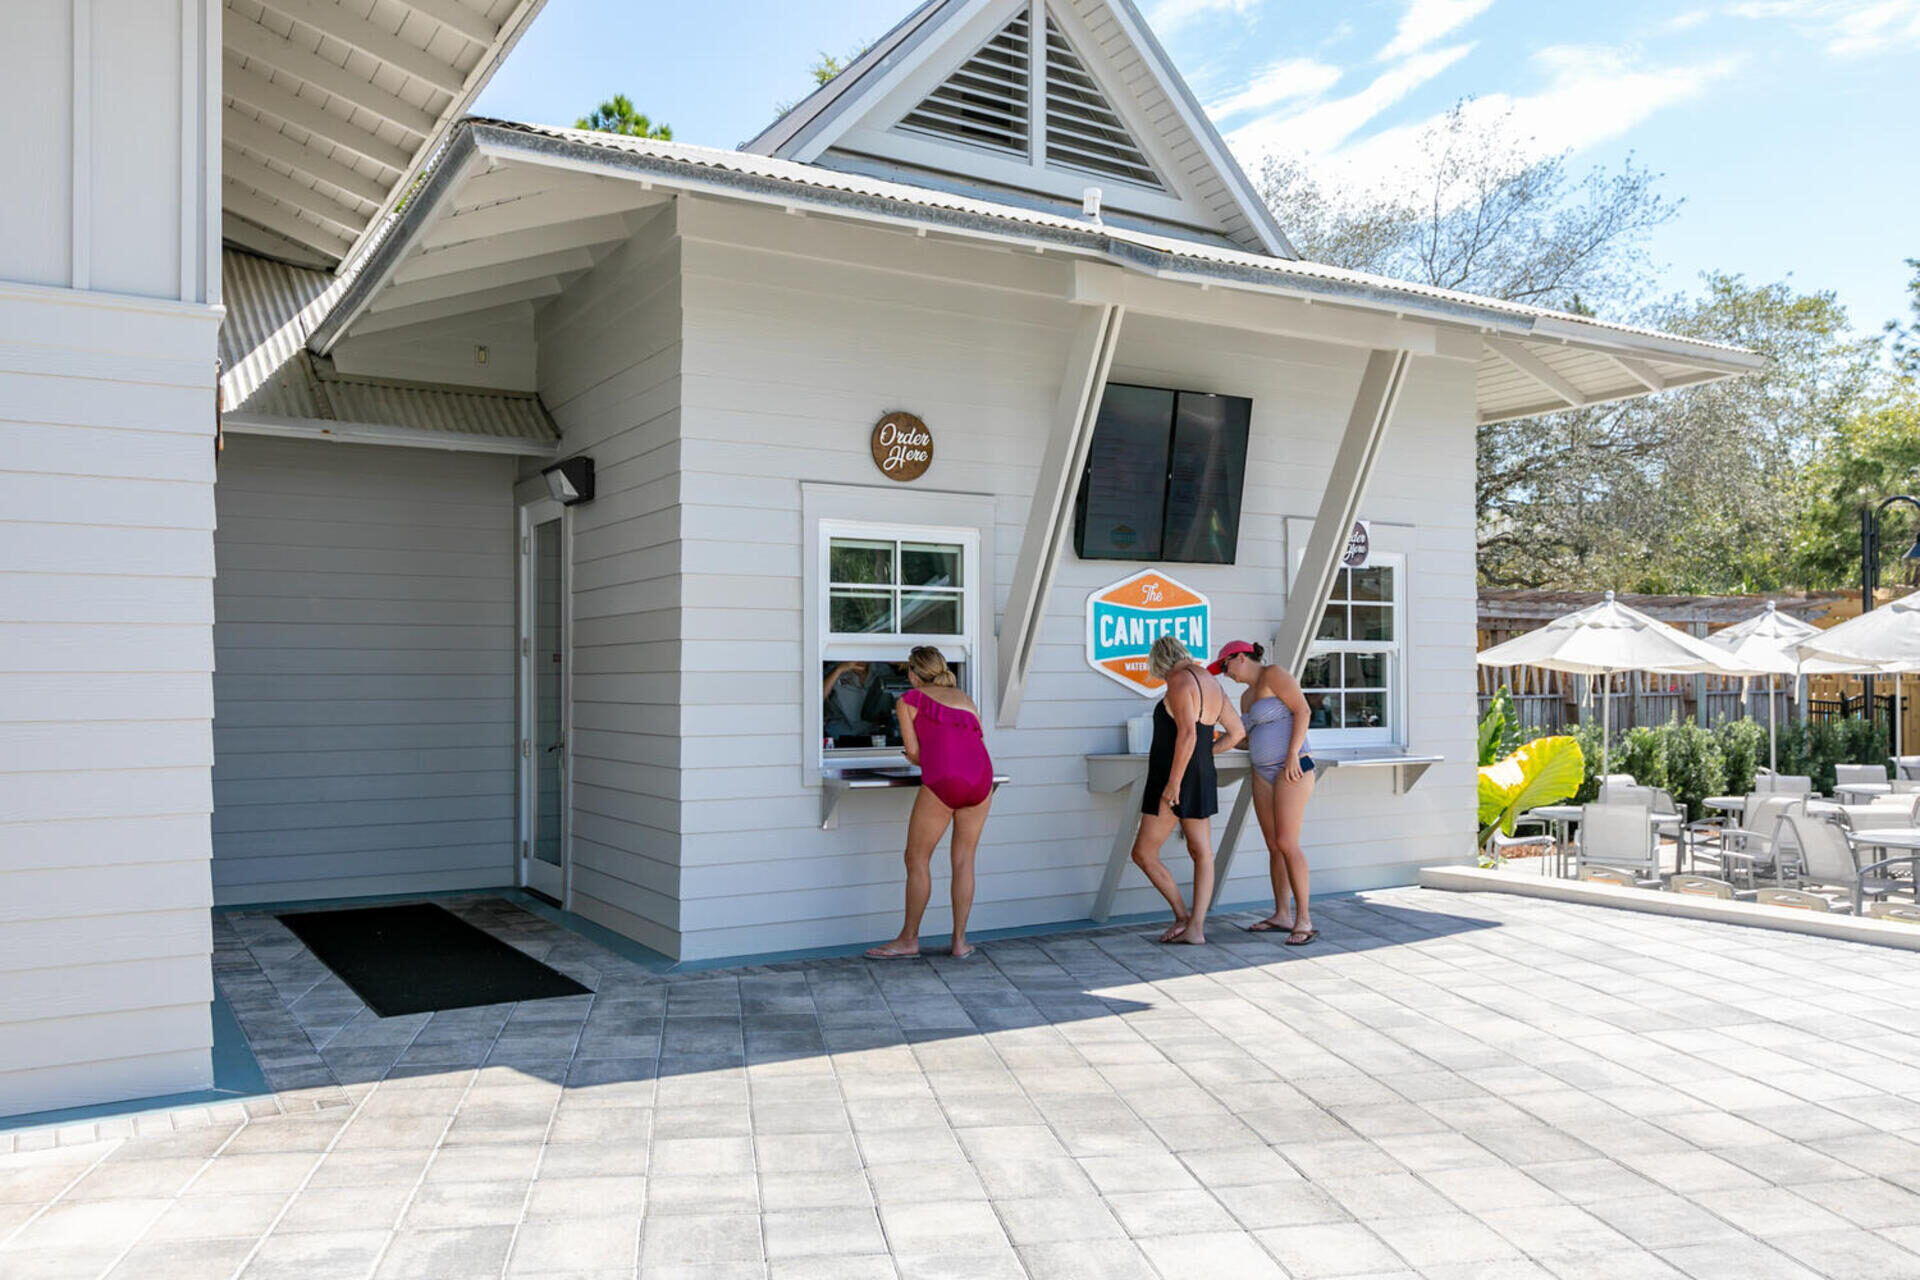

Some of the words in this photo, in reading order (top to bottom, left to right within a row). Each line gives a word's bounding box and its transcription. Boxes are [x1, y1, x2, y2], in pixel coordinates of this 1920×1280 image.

[880, 423, 930, 446] Order
[883, 445, 928, 471] Here
[1141, 583, 1163, 604] The
[1100, 614, 1204, 648] CANTEEN
